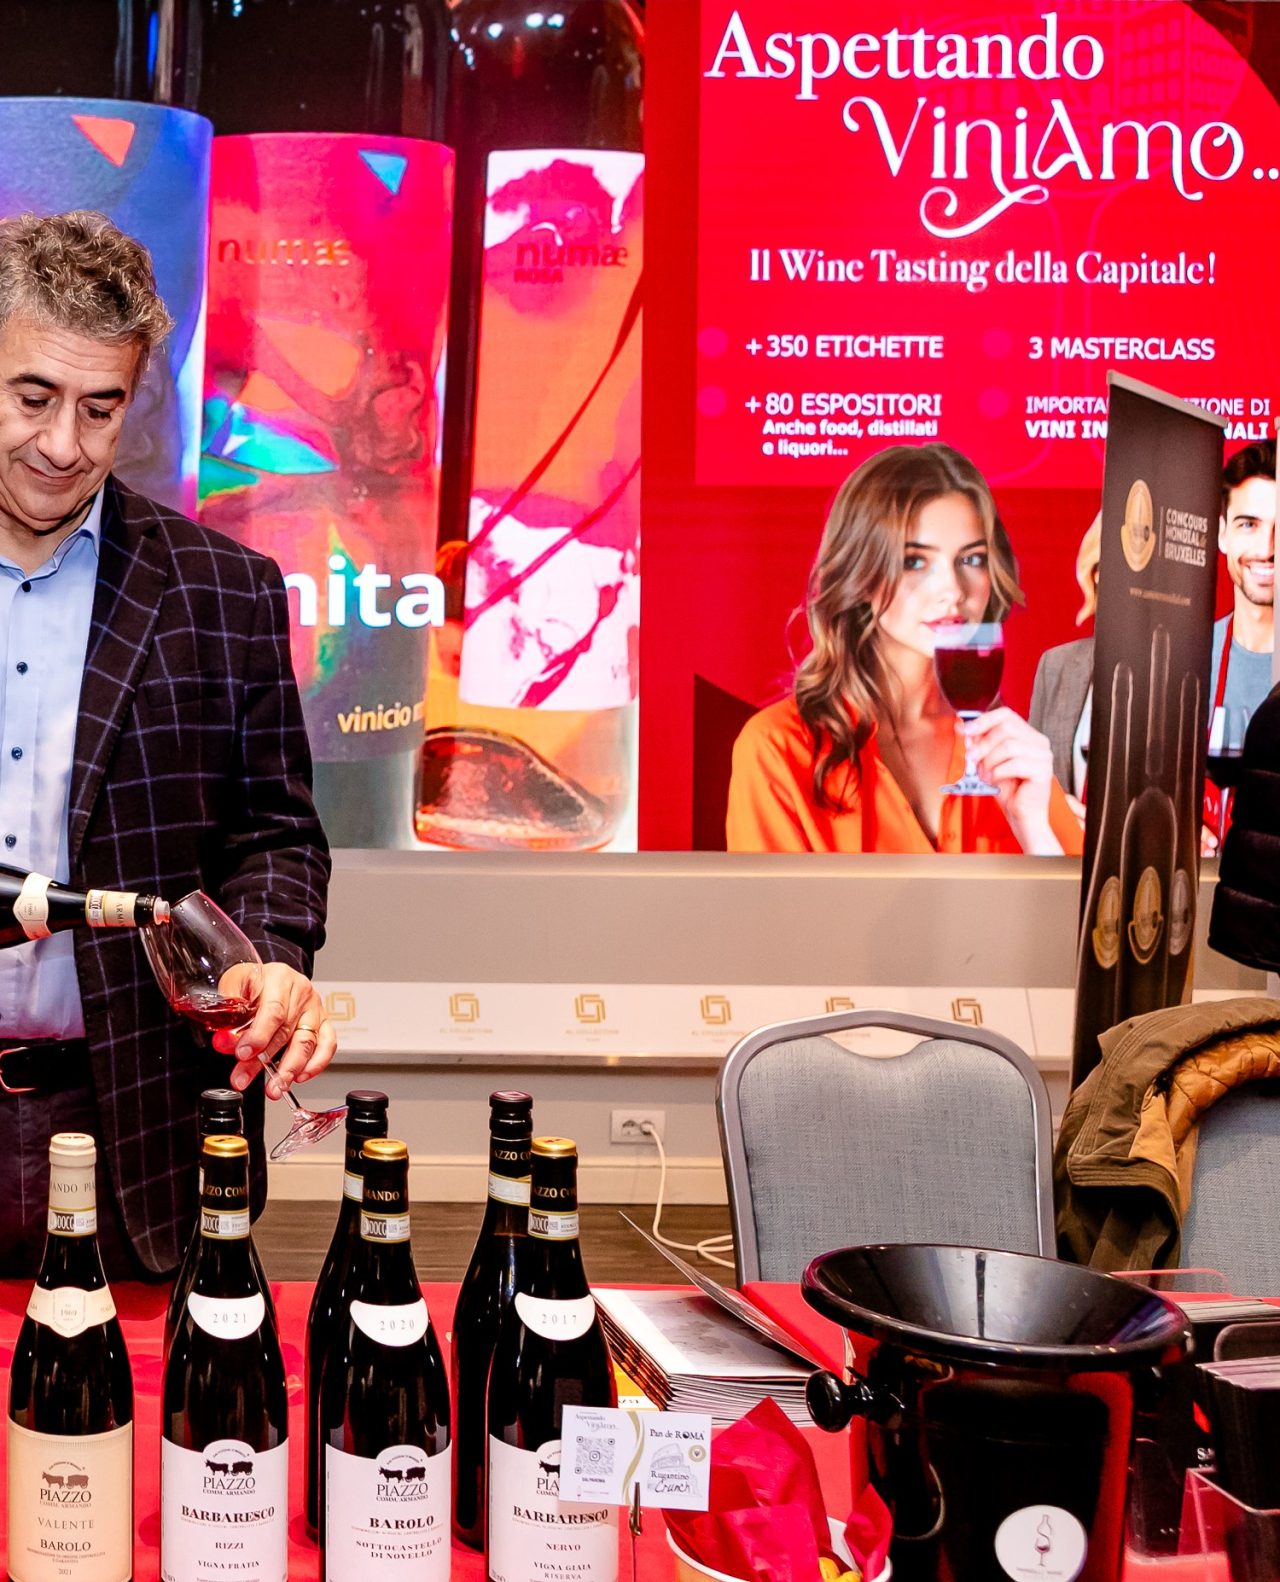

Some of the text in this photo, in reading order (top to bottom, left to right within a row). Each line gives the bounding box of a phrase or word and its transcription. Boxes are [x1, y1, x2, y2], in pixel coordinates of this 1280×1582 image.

[703, 10, 1106, 100] Aspettando
[749, 248, 1216, 294] Il Wine Tasting della Capitale!
[766, 334, 808, 358] 350
[815, 335, 944, 358] ETICHETTE
[1029, 337, 1216, 360] 3 MASTERCLASS
[765, 392, 794, 416] 80
[801, 393, 942, 416] ESPOSITORI
[1026, 396, 1108, 415] IMPORTA
[1250, 398, 1270, 416] DI
[762, 419, 938, 439] Anche food, distillati
[1025, 420, 1076, 439] VINI
[762, 439, 849, 458] e liquori...
[1166, 508, 1208, 534] CONCOURS
[1165, 525, 1200, 548] MONDIAL
[1164, 541, 1207, 568] BRUXELLES
[212, 1313, 247, 1325] 2021
[379, 1319, 416, 1332] 2020
[541, 1313, 578, 1325] 2017
[650, 1428, 664, 1438] Pan
[665, 1430, 673, 1438] de
[203, 1476, 256, 1490] PIAZZO
[377, 1482, 429, 1497] PIAZZO
[536, 1477, 560, 1491] PIA
[40, 1488, 92, 1503] PIAZZO
[181, 1504, 275, 1523] BARBARESCO
[513, 1505, 609, 1525] BARBARESCO
[38, 1516, 95, 1530] VALENTE
[369, 1515, 435, 1530] BAROLO
[40, 1538, 92, 1552] BAROLO
[215, 1541, 244, 1550] RIZZI
[355, 1536, 443, 1552] SOTTOCASTELLO
[545, 1542, 582, 1552] NERVO
[370, 1549, 433, 1560] DI NOVELLO
[197, 1560, 260, 1570] VIGNA FRATIN
[533, 1561, 563, 1571] VIGNA
[544, 1572, 582, 1580] RISERVA
